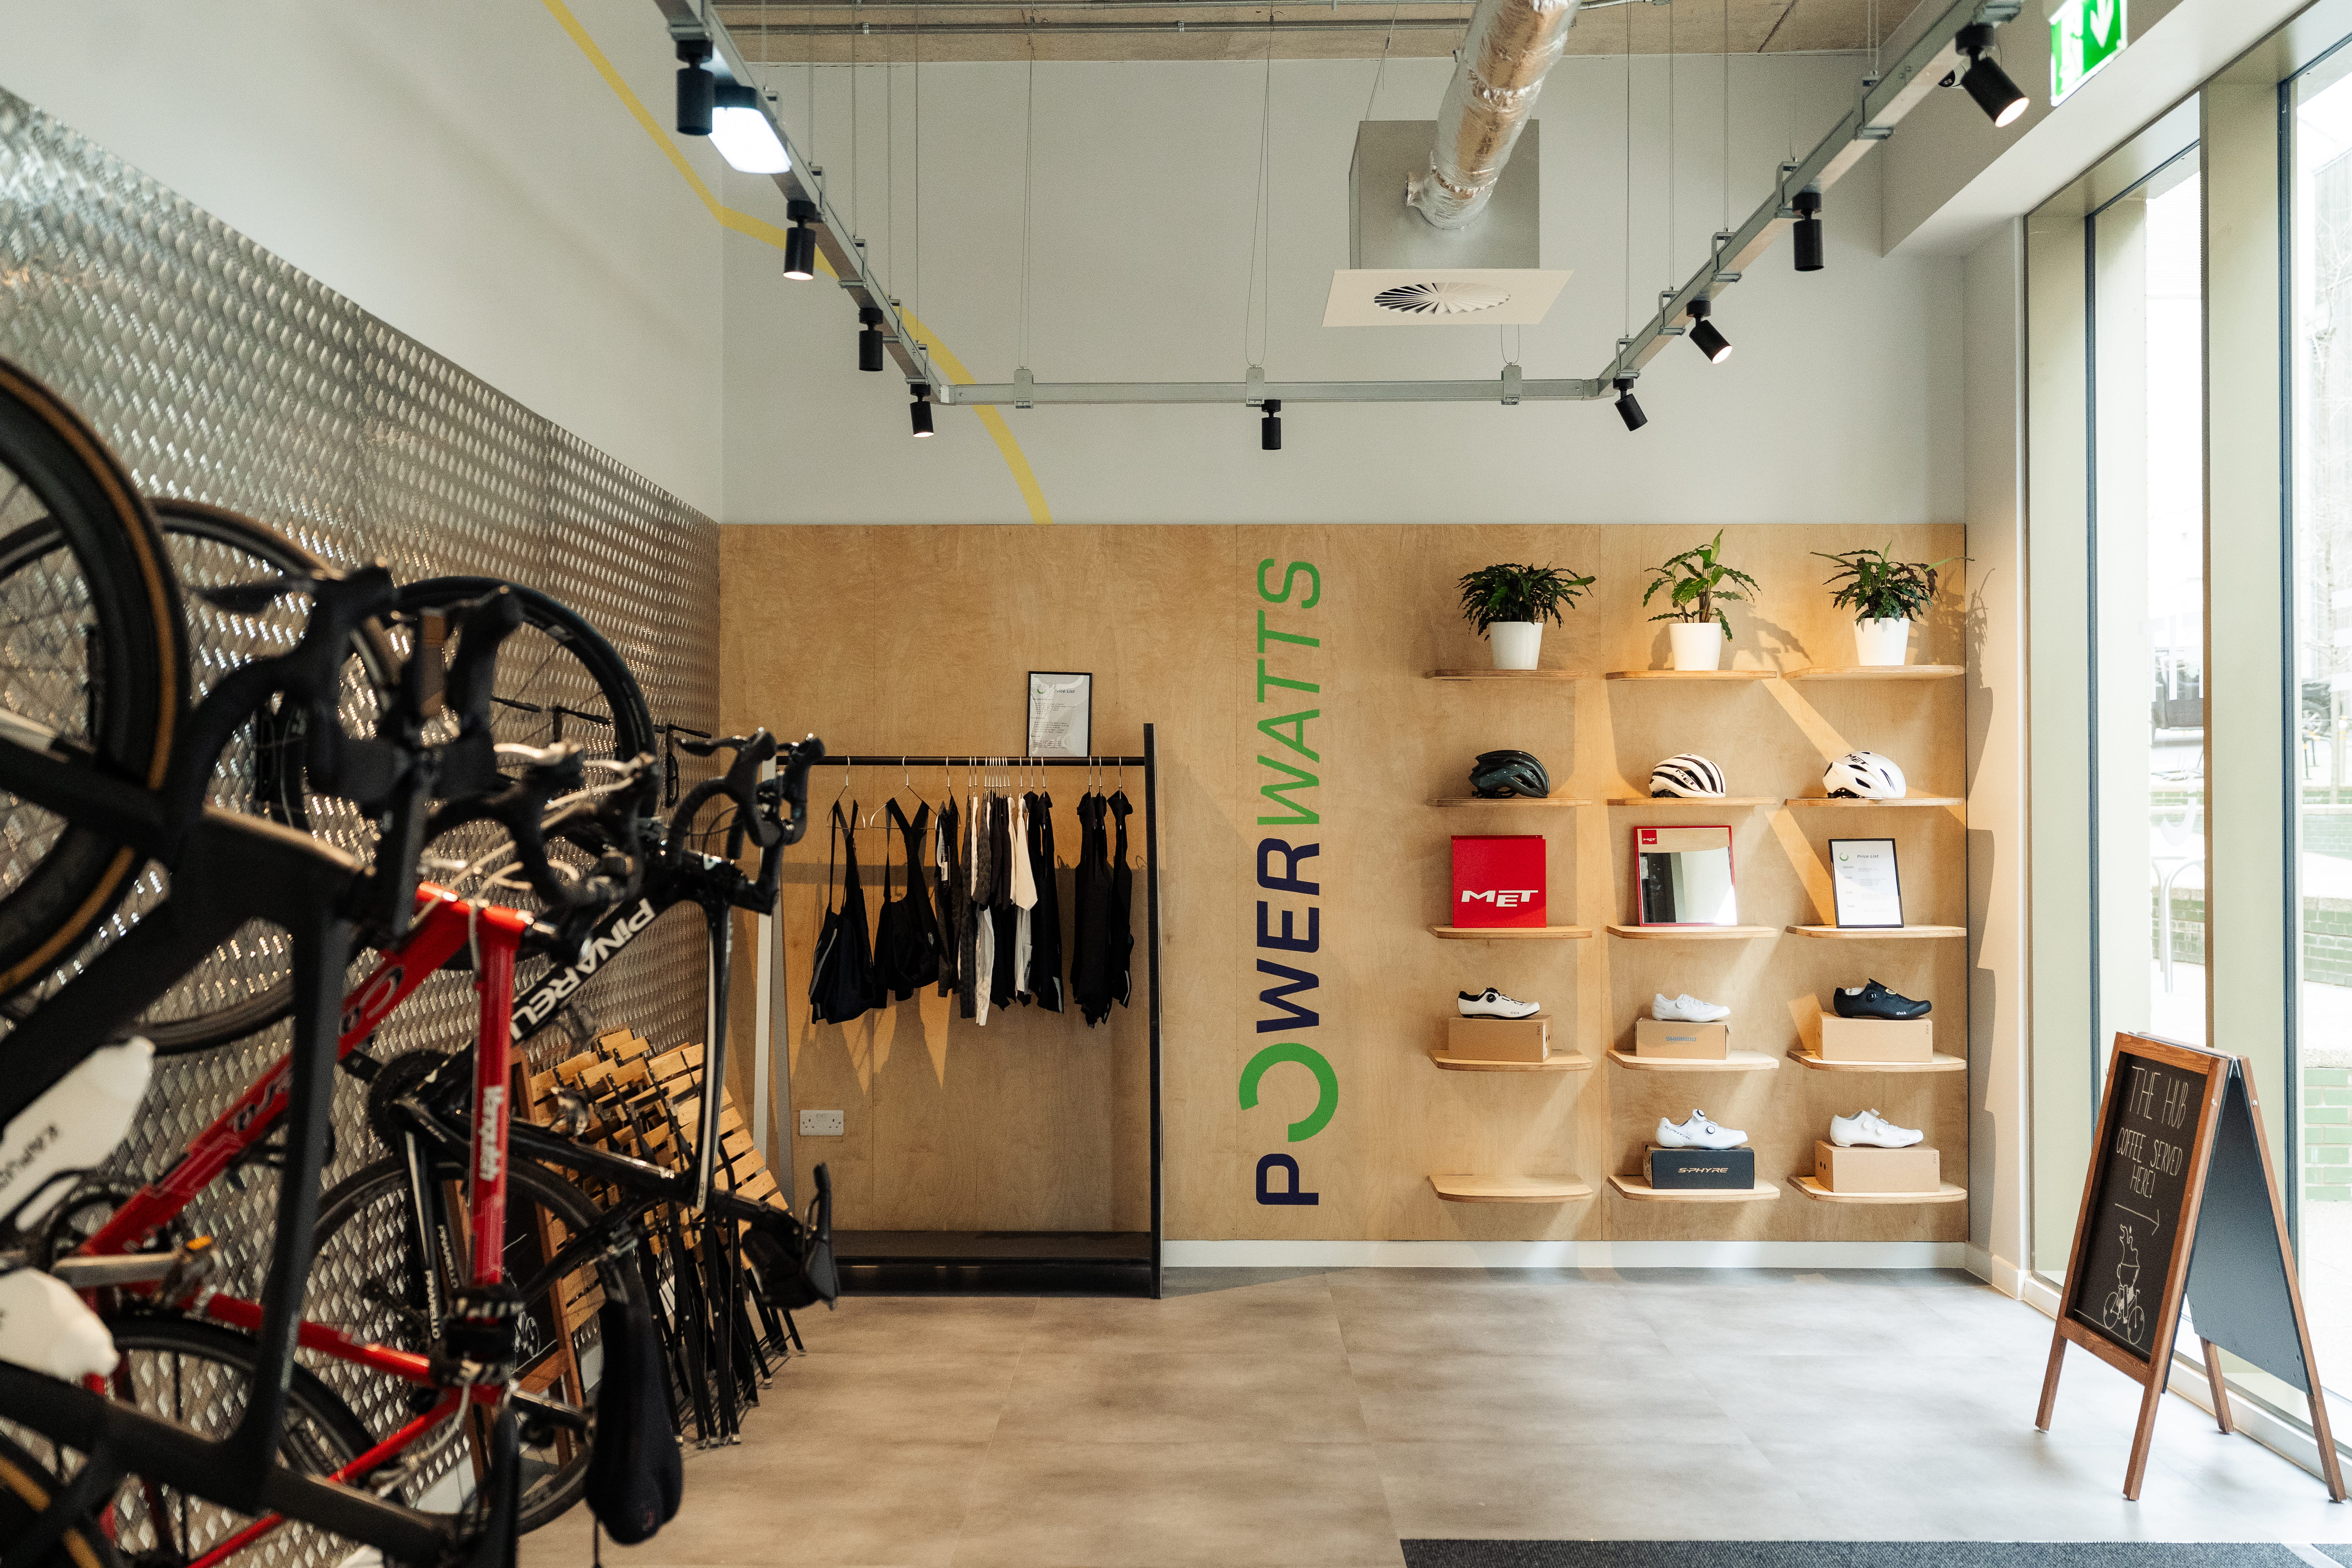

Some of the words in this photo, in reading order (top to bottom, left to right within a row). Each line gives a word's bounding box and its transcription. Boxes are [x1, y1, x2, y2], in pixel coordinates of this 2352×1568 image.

[1675, 769, 1697, 785] MET
[1844, 754, 1869, 765] MET
[1239, 559, 1338, 1205] POWERWATTS
[1461, 890, 1538, 907] MET
[2129, 1066, 2161, 1120] THE
[2161, 1077, 2188, 1129] HUB
[2117, 1127, 2146, 1163] COFFEE
[2150, 1139, 2183, 1176] SERVED
[2130, 1163, 2156, 1198] HERE!
